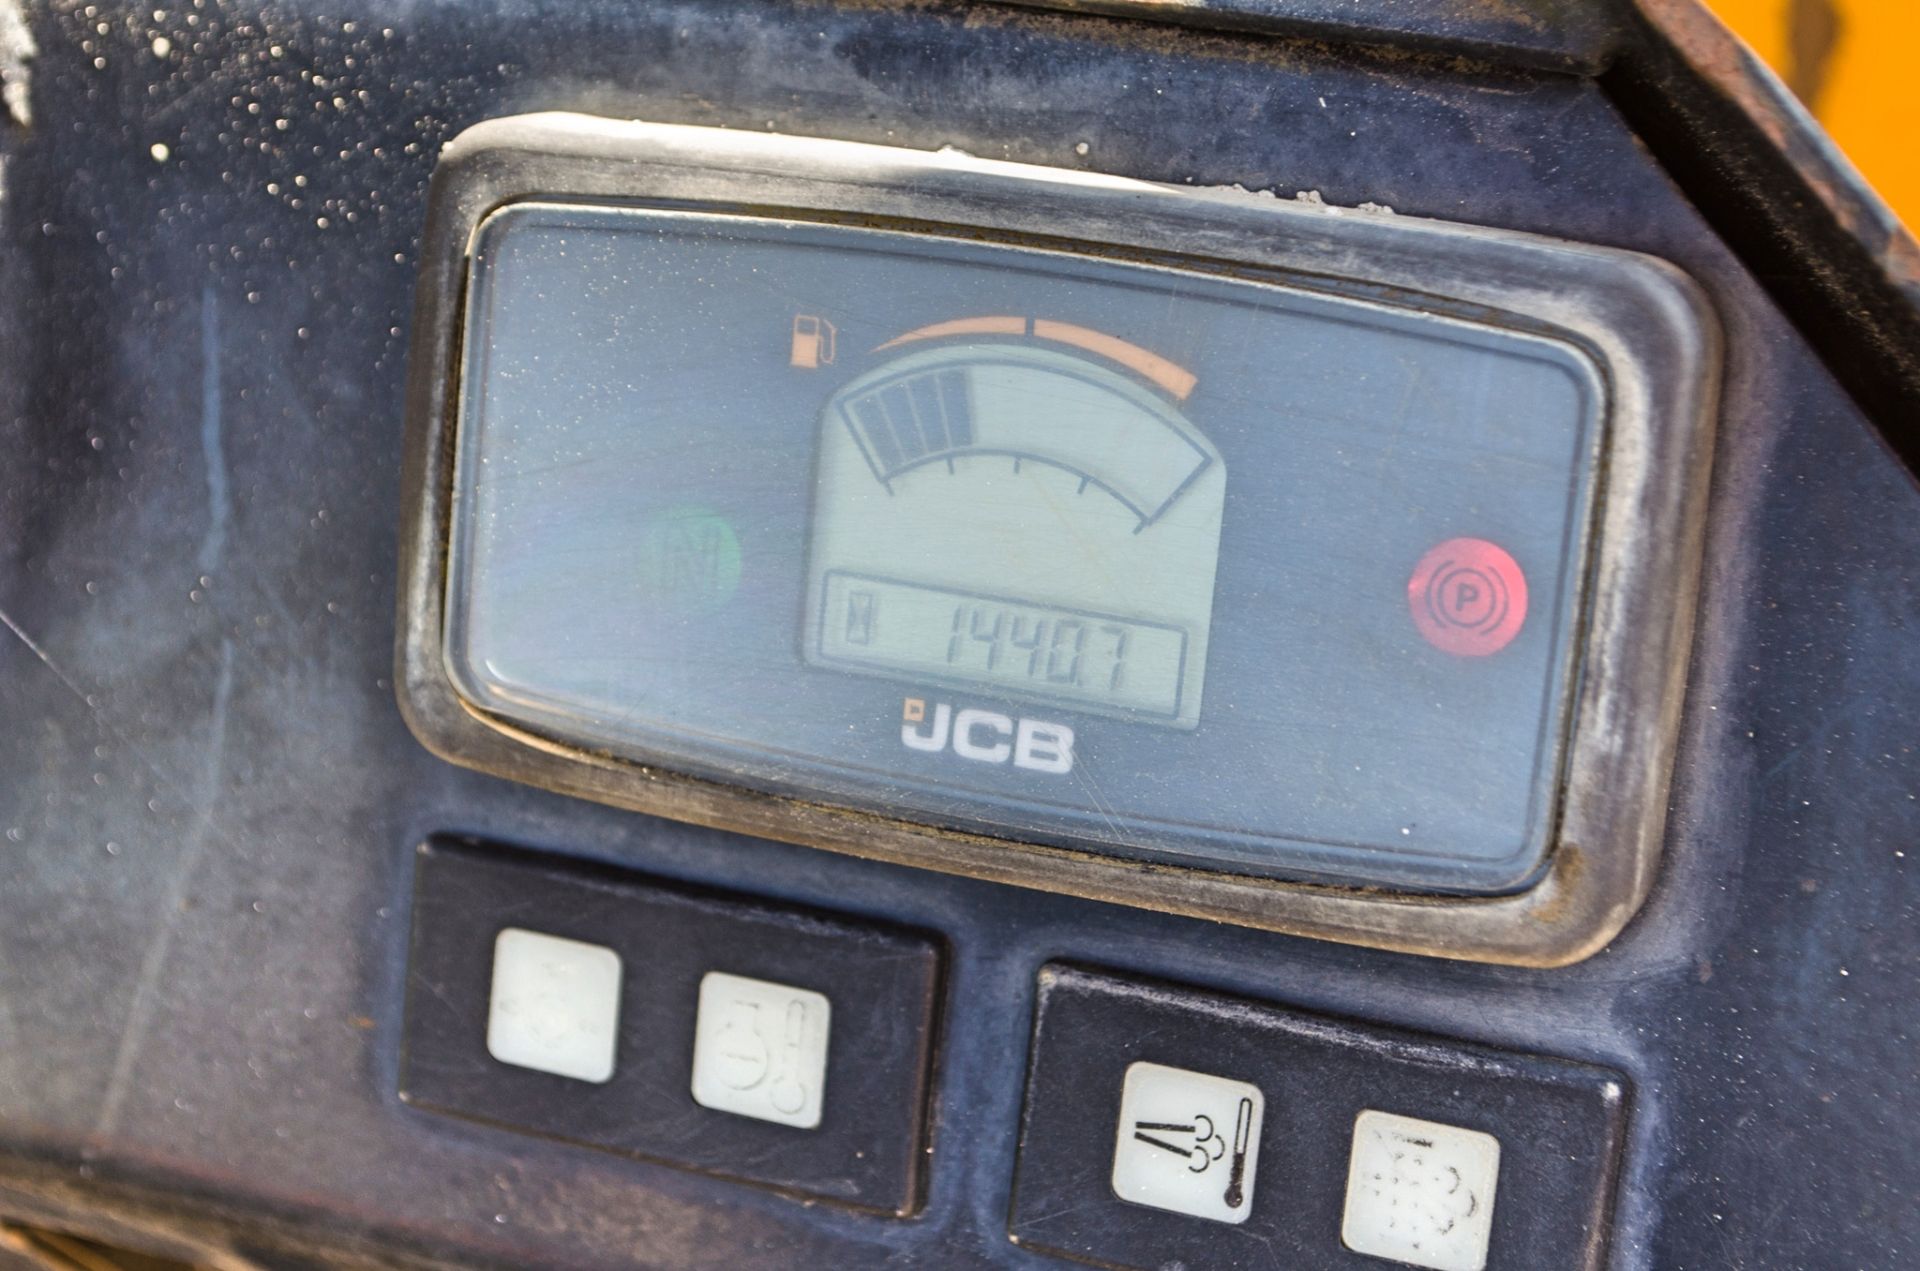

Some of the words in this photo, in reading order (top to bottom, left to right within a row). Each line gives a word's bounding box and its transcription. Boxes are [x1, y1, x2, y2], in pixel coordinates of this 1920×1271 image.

[1455, 582, 1480, 612] P
[947, 604, 1128, 691] 14407
[901, 702, 1075, 774] JCB
